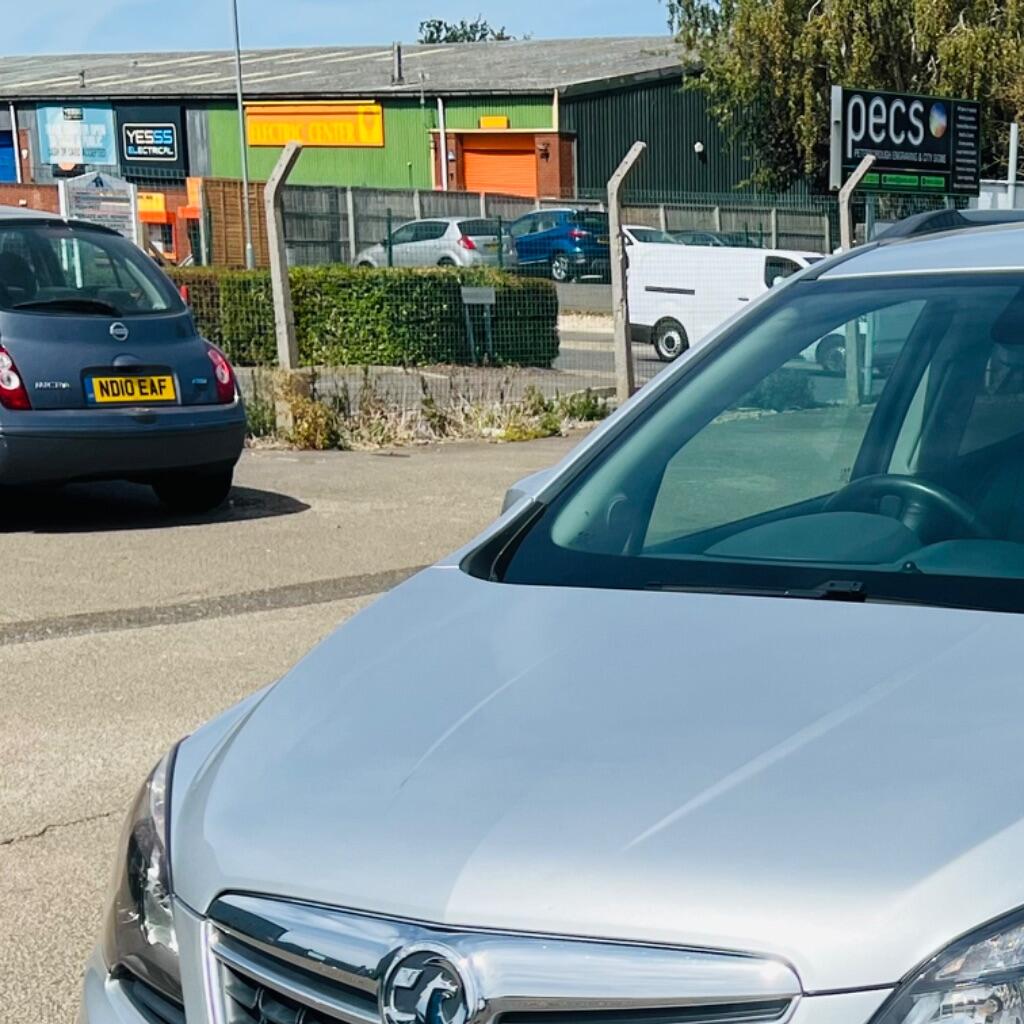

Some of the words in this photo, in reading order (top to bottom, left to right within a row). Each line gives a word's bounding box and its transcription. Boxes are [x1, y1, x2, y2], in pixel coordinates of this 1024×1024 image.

[847, 94, 924, 159] pecs
[126, 129, 173, 145] YESSS
[99, 380, 135, 398] ND10
[137, 378, 168, 397] EAF
